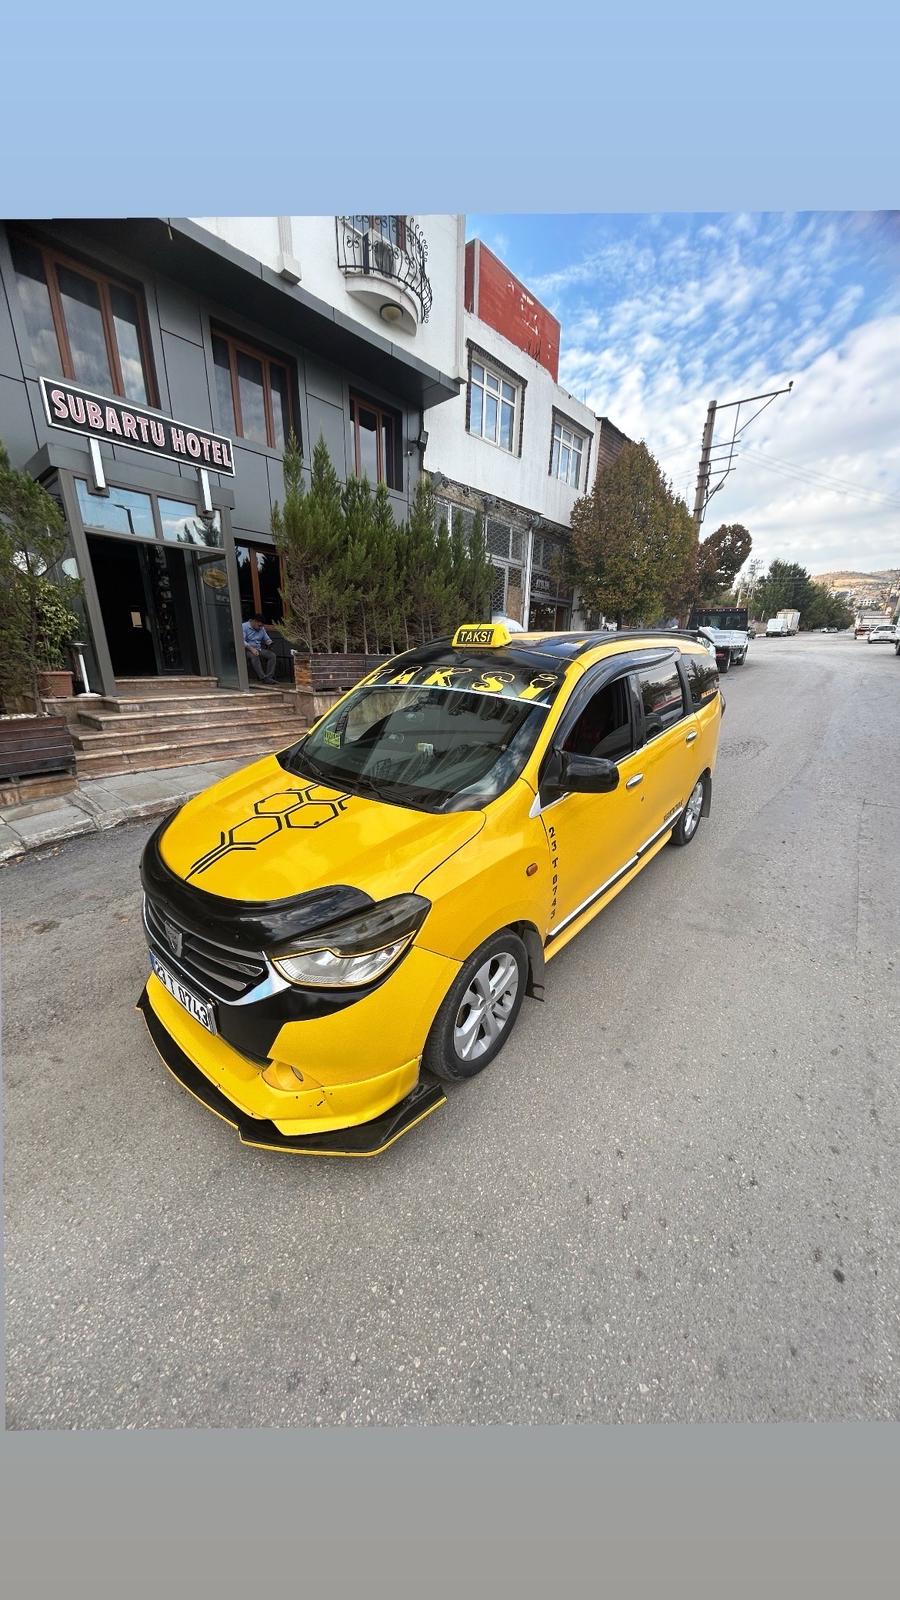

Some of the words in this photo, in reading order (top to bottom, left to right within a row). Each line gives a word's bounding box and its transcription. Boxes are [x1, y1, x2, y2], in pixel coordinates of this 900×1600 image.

[51, 389, 166, 447] SUBARTU
[171, 426, 232, 468] HOTEL
[167, 974, 176, 996] T
[178, 985, 209, 1028] 0743
